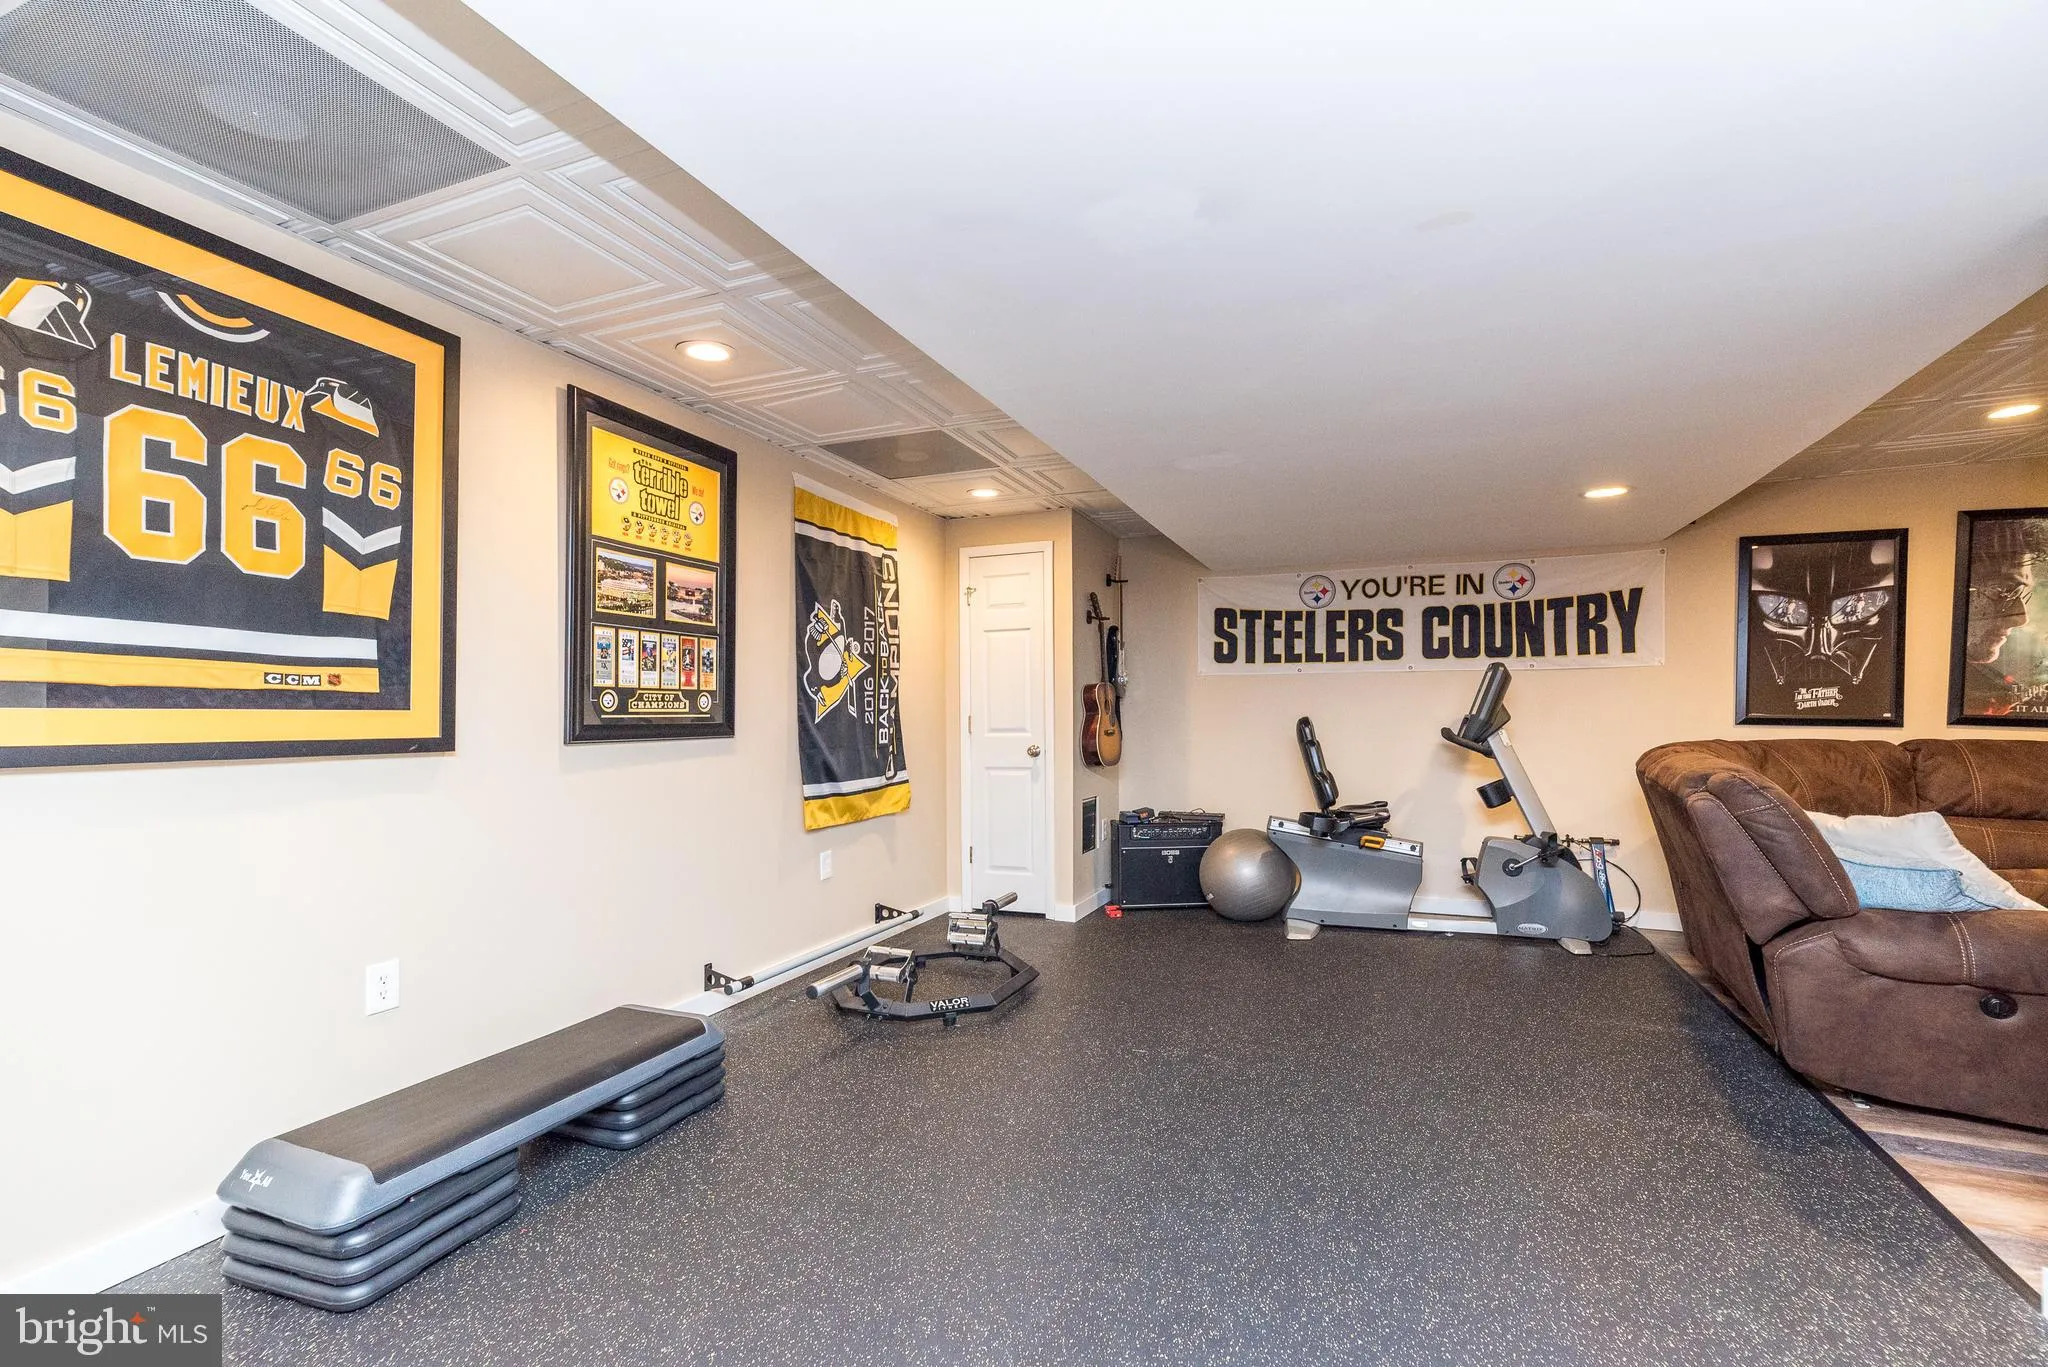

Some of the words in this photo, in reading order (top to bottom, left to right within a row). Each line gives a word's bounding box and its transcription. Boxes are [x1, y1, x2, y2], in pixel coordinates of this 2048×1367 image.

[0, 365, 77, 434] 6
[110, 333, 305, 433] LEMIEUX
[103, 404, 307, 579] 66
[323, 448, 402, 510] 66
[633, 460, 688, 498] terrible
[640, 488, 680, 521] towel
[1341, 575, 1445, 600] YOU'RE
[1456, 573, 1484, 596] IN
[864, 606, 875, 655] 2017
[877, 590, 889, 659] BACK
[1213, 607, 1404, 664] STEELERS
[1421, 587, 1644, 660] COUNTRY
[264, 673, 321, 686] CCM
[881, 553, 901, 781] CAMPIONS
[631, 701, 685, 709] CHAMPIONS
[864, 677, 875, 725] 2016
[878, 676, 890, 745] BACK
[930, 997, 968, 1007] VALOR
